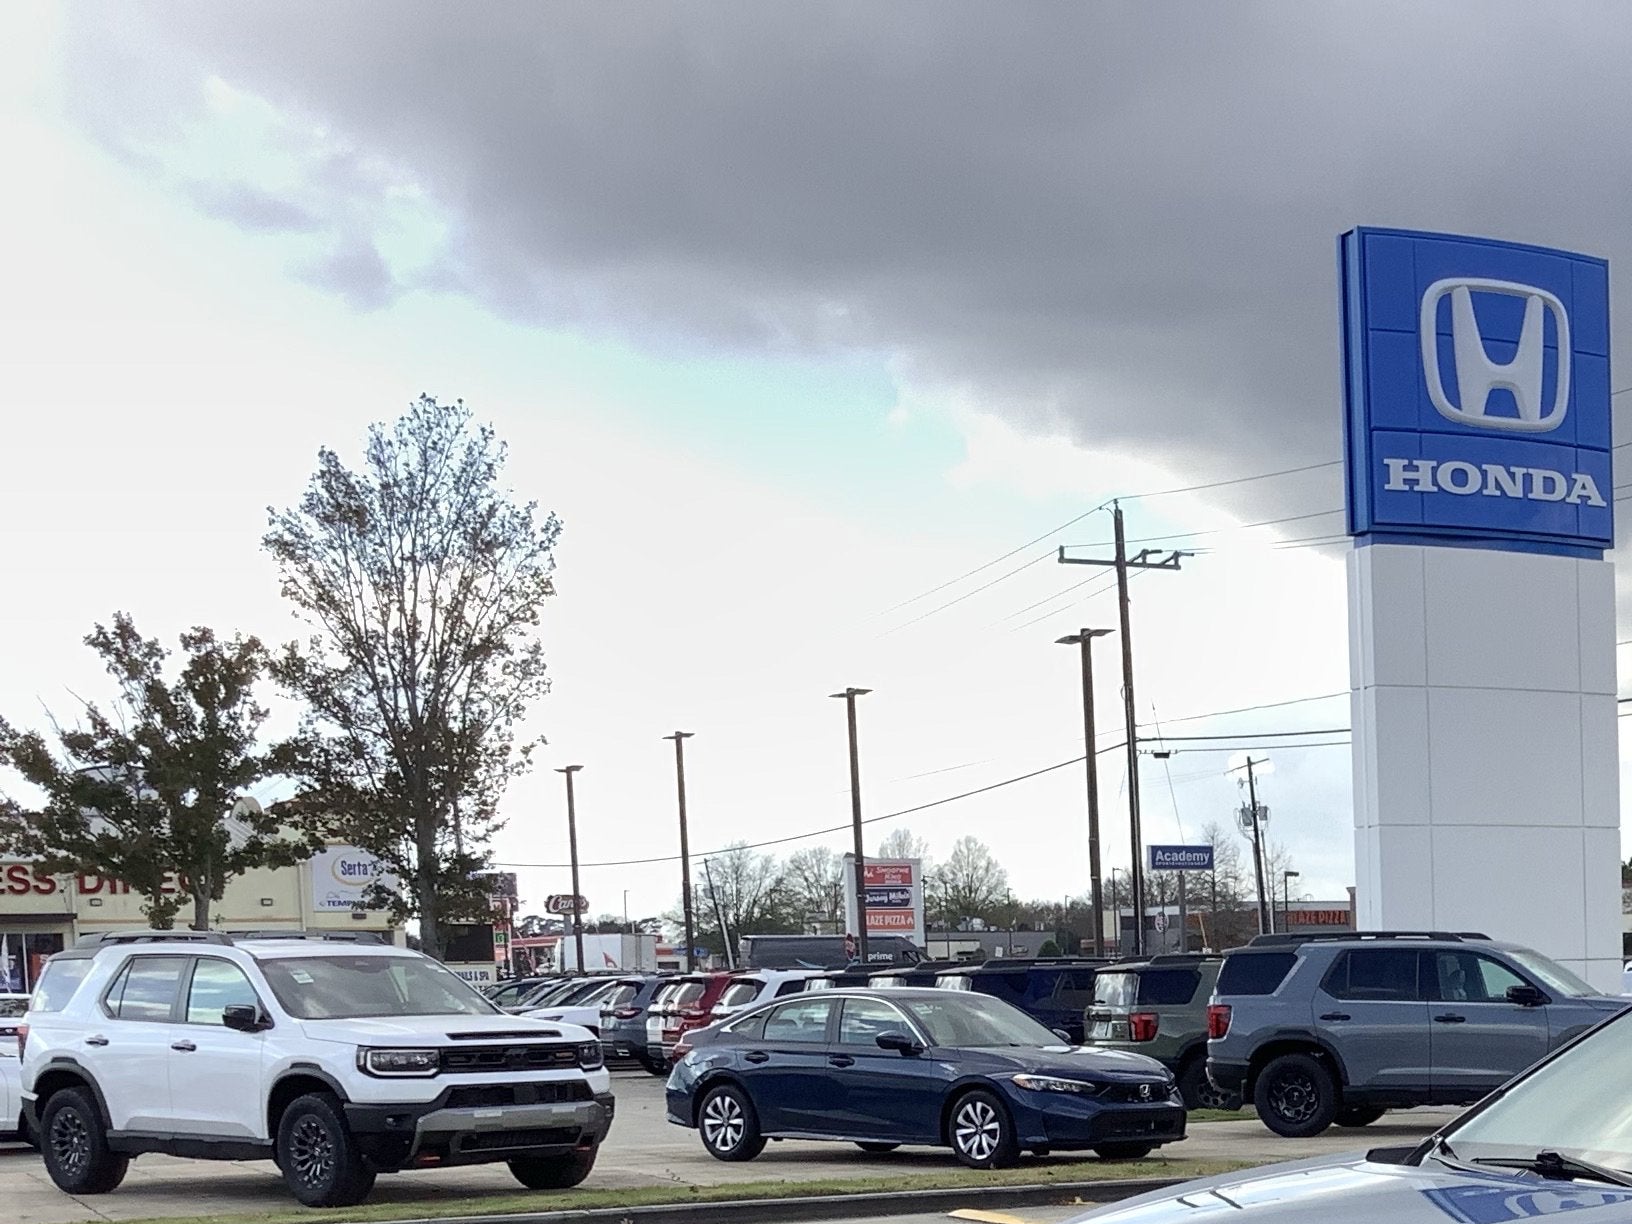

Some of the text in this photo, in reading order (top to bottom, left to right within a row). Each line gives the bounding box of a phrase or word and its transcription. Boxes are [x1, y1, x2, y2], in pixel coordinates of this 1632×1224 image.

[1383, 458, 1607, 507] HONDA
[1155, 850, 1210, 865] Academy
[341, 860, 369, 876] Serta
[884, 914, 906, 926] PIZZA
[1318, 910, 1346, 925] PIZZA
[867, 951, 893, 962] prime
